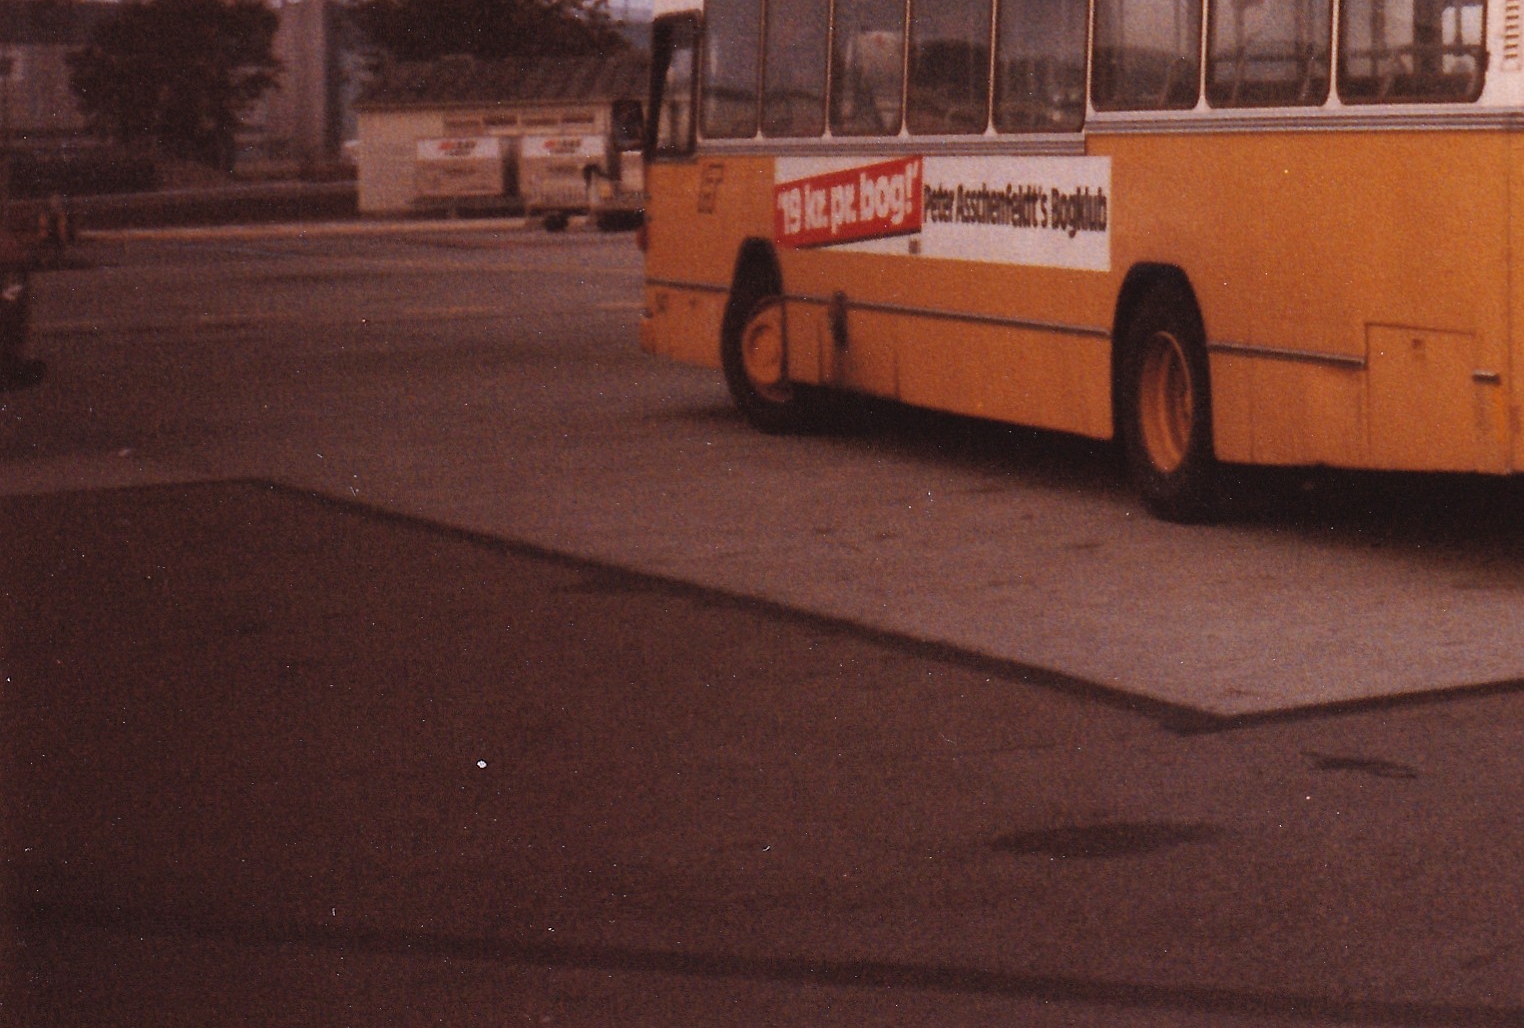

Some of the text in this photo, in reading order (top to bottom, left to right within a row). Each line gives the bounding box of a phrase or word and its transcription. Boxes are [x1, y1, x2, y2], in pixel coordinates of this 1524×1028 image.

[830, 183, 857, 235] pr.
[923, 184, 954, 223] Peter
[1051, 186, 1107, 239] Bogklub
